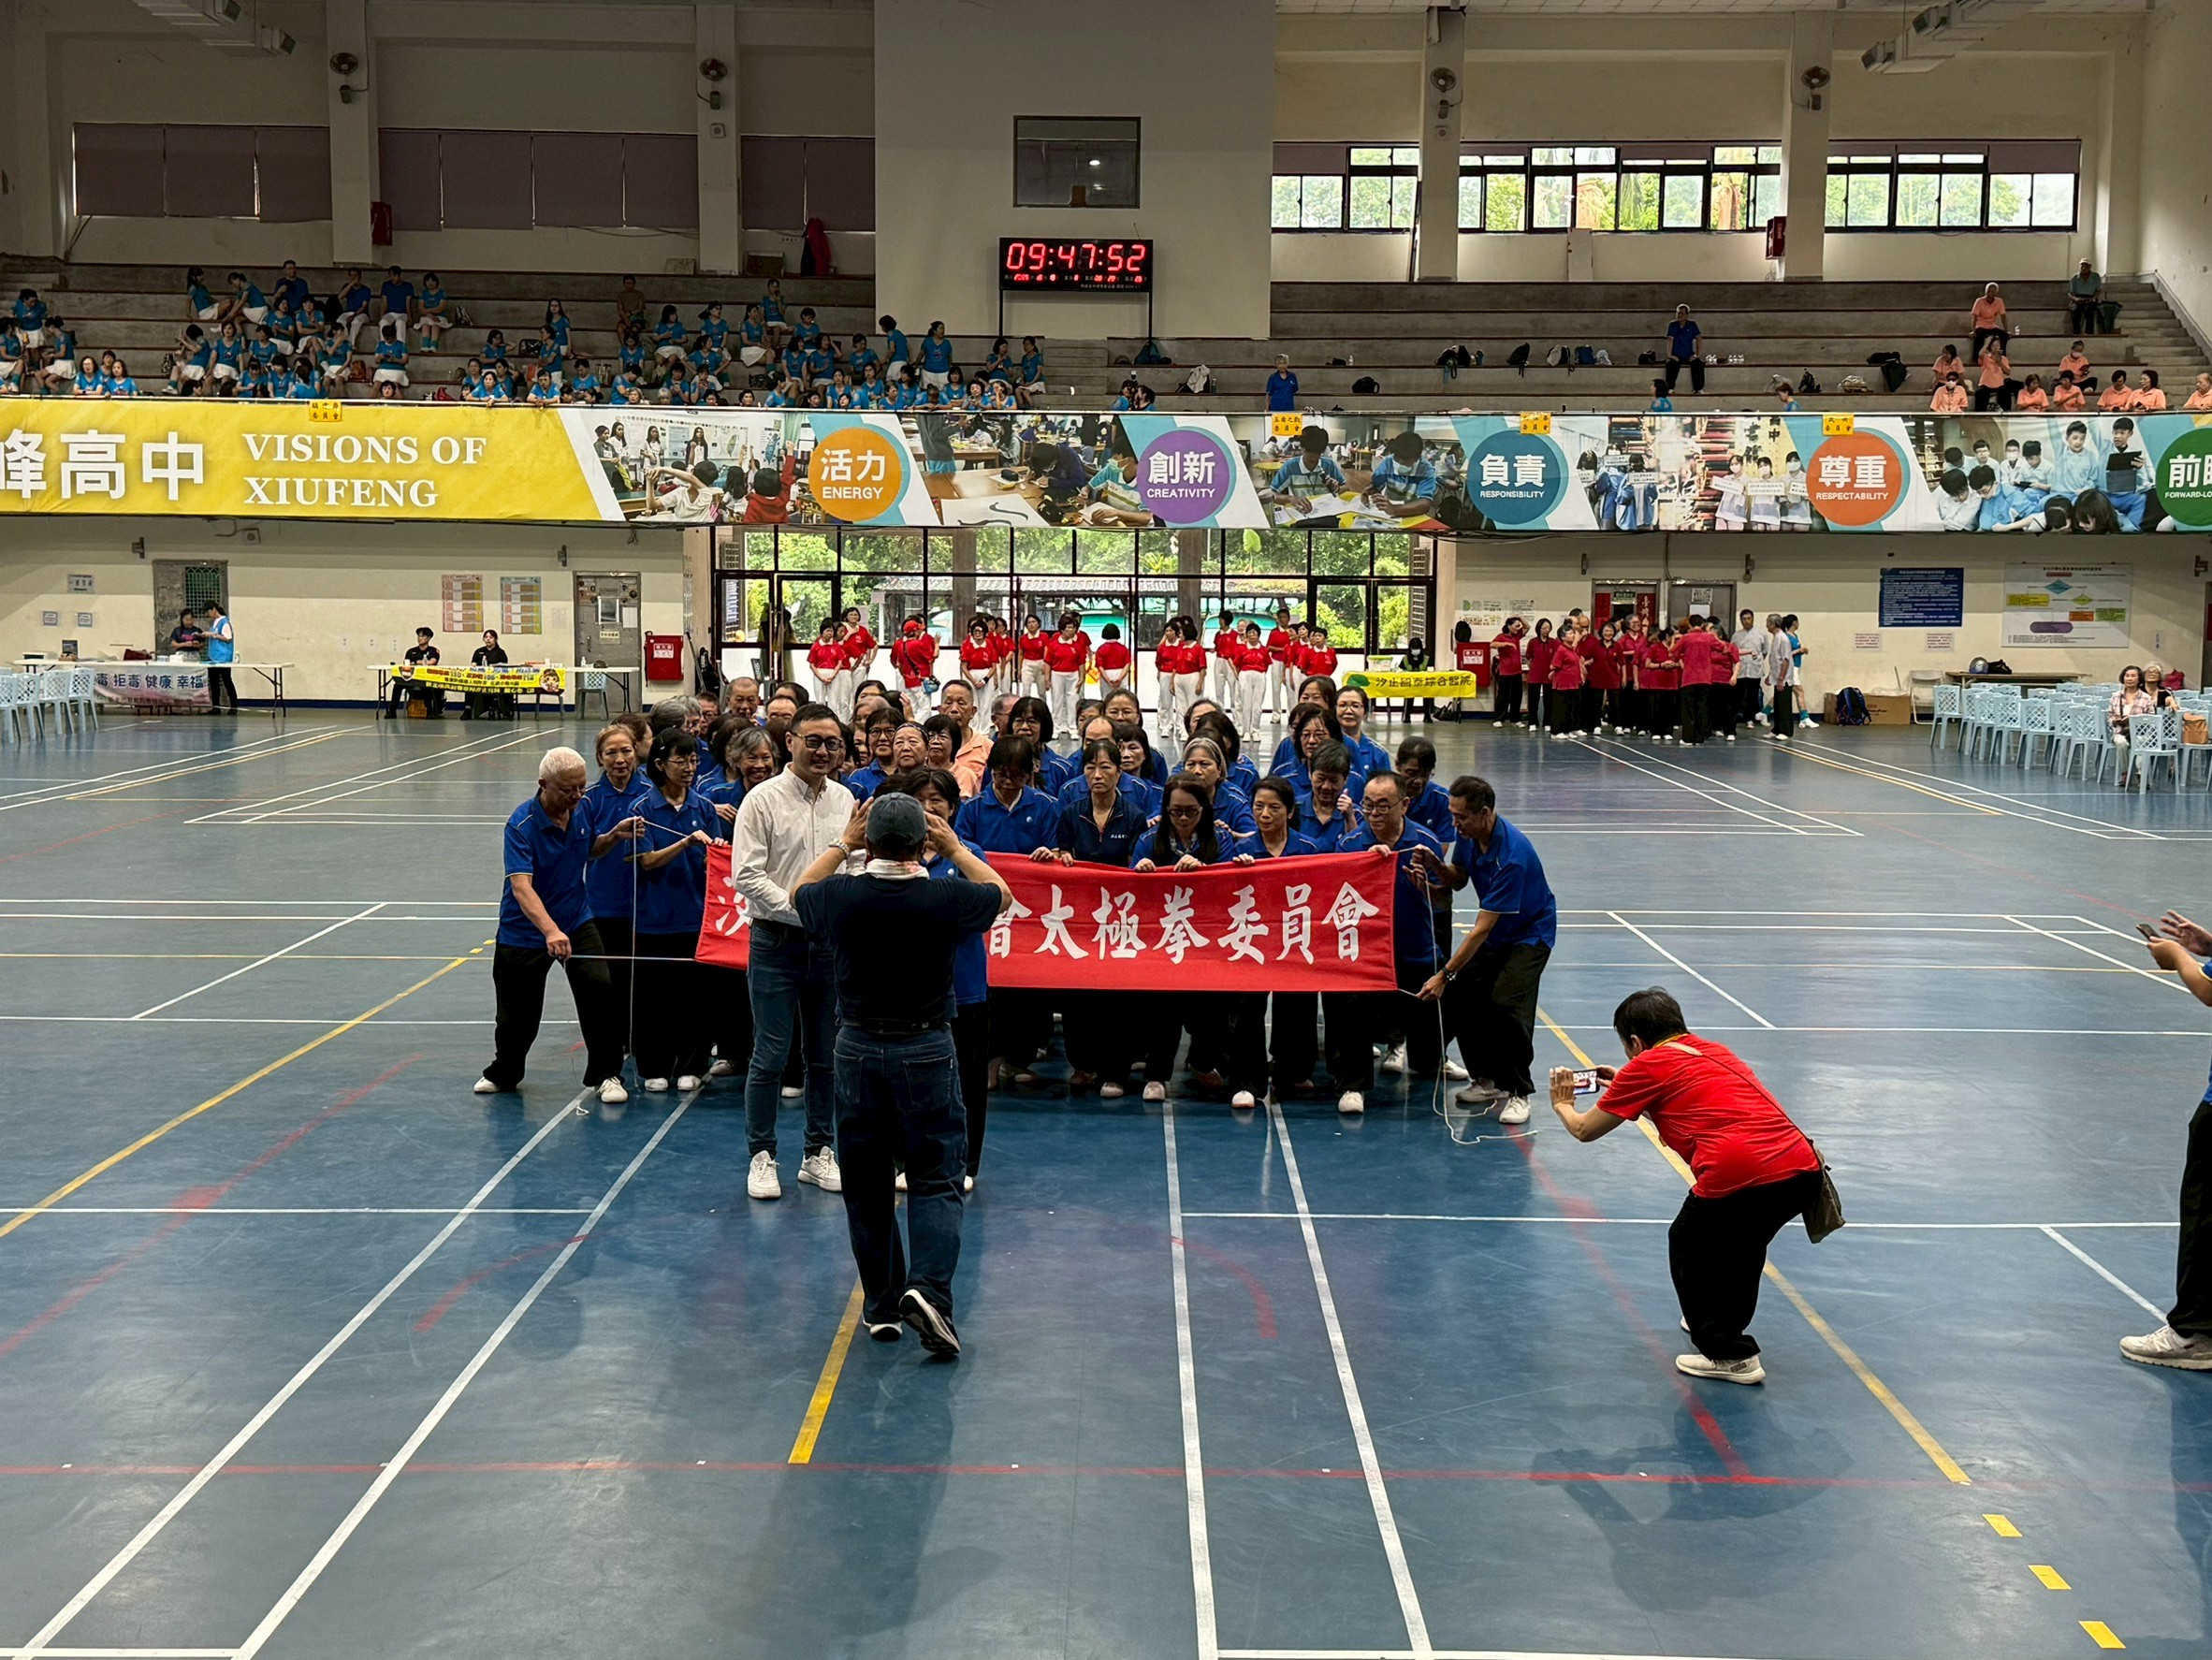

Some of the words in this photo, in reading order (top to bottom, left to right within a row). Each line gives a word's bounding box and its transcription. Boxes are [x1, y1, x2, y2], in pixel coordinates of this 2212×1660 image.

[1006, 242, 1145, 271] 09:47:52
[241, 433, 419, 464] VISIONS
[431, 436, 487, 464] OF
[0, 429, 204, 501] 峰高中
[820, 448, 886, 482] 活力
[1147, 451, 1215, 485] 創新
[1479, 453, 1546, 488] 負責
[1818, 455, 1887, 488] 尊重
[243, 476, 439, 507] XIUFENG
[822, 486, 884, 500] ENERGY
[1146, 488, 1215, 499] CREATIVITY
[1479, 490, 1546, 499] RESPONSIBILITY
[1815, 491, 1888, 501] RESPECTABILITY
[113, 674, 140, 688] 拒毒
[145, 675, 172, 689] 健康
[177, 675, 204, 689] 幸福
[1375, 676, 1472, 688] 汐止國泰綜合醫院
